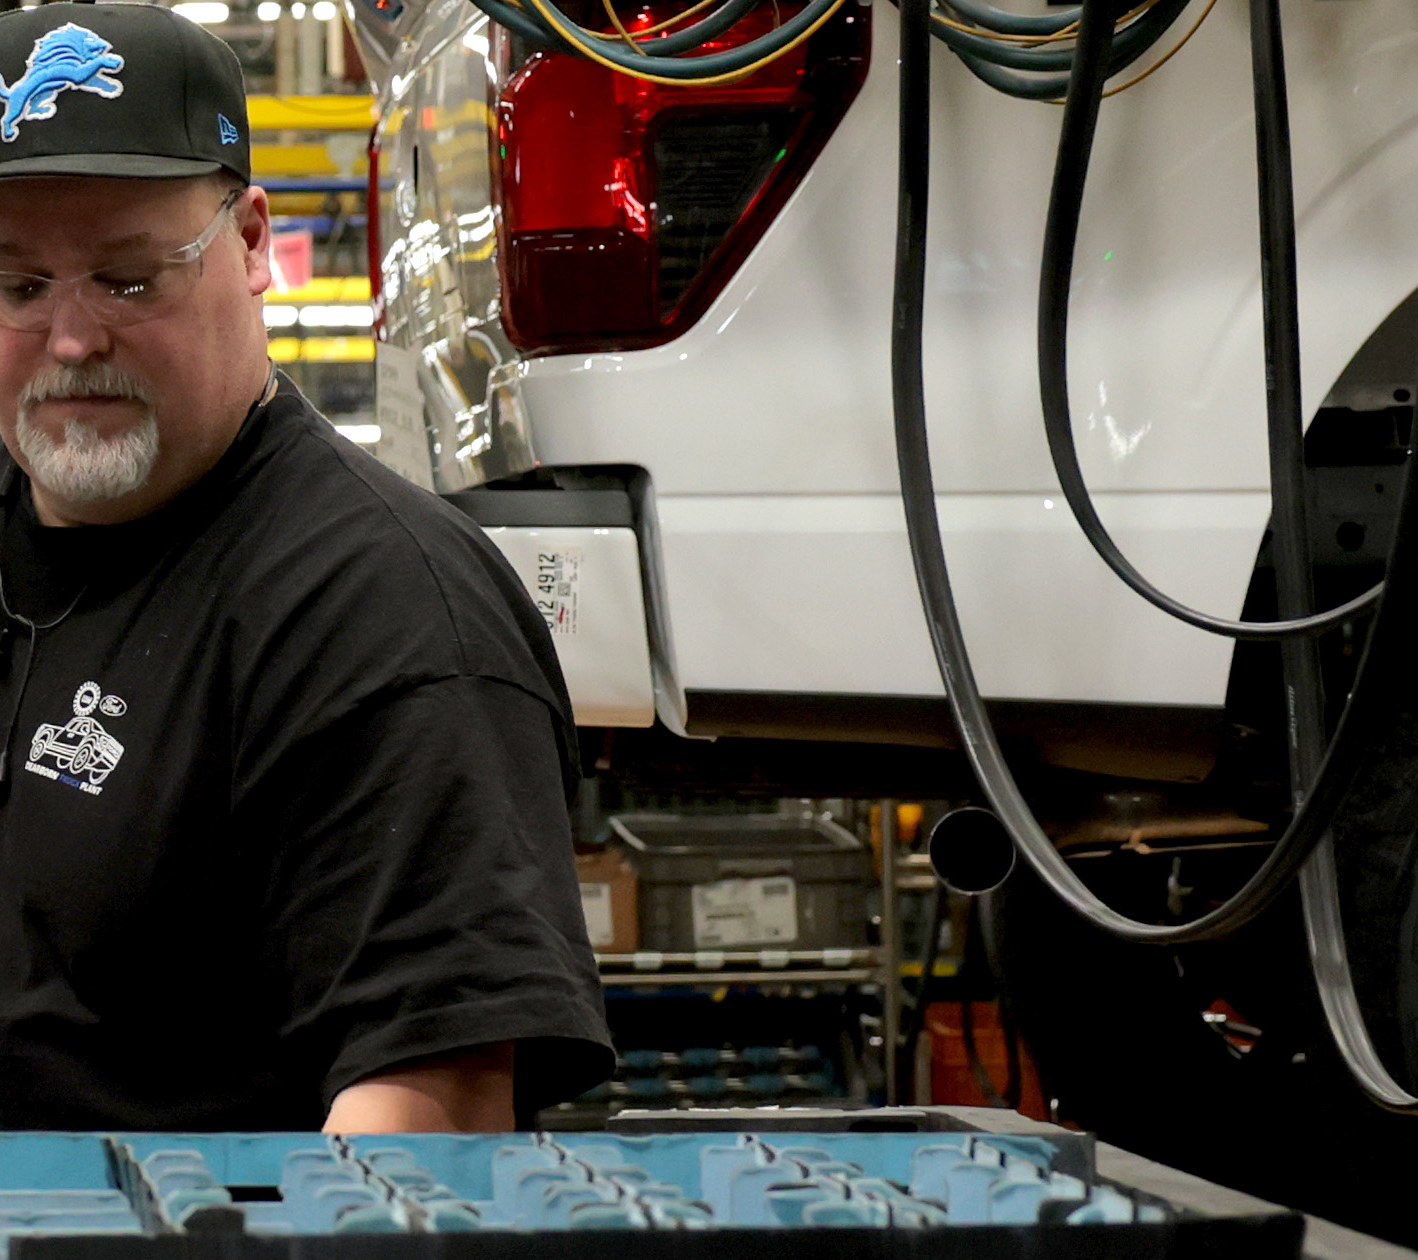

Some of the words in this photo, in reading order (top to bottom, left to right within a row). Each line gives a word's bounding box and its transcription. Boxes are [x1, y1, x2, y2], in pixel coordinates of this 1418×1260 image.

[538, 553, 555, 594] 4912
[25, 761, 60, 780] DEARBORN
[79, 782, 103, 796] PLANT
